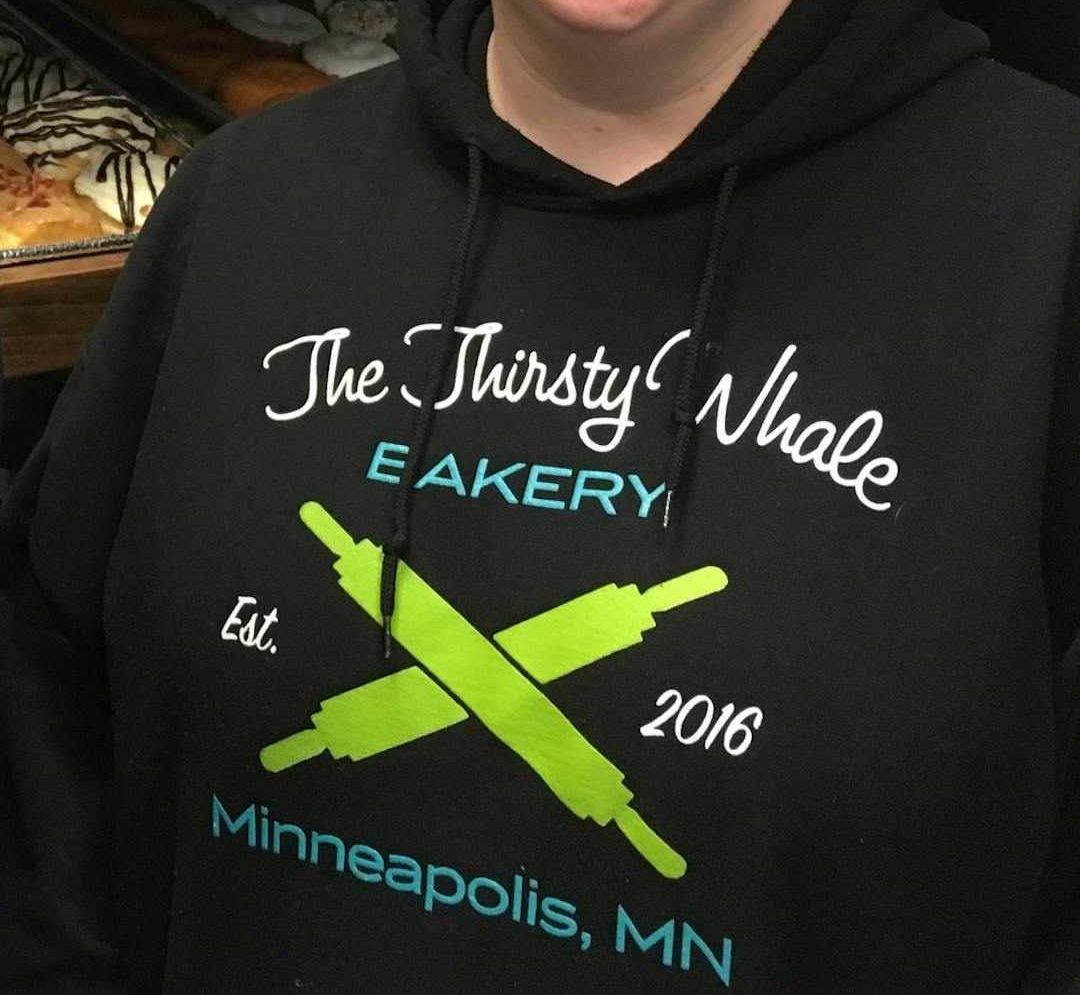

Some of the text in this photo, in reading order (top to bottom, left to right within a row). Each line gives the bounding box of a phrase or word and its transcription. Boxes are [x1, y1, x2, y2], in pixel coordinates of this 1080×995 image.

[262, 327, 390, 422] The
[400, 321, 642, 453] Thirsty
[220, 595, 279, 655] Est.
[639, 688, 764, 757] 2016
[211, 793, 733, 988] Minneapolis, MN
